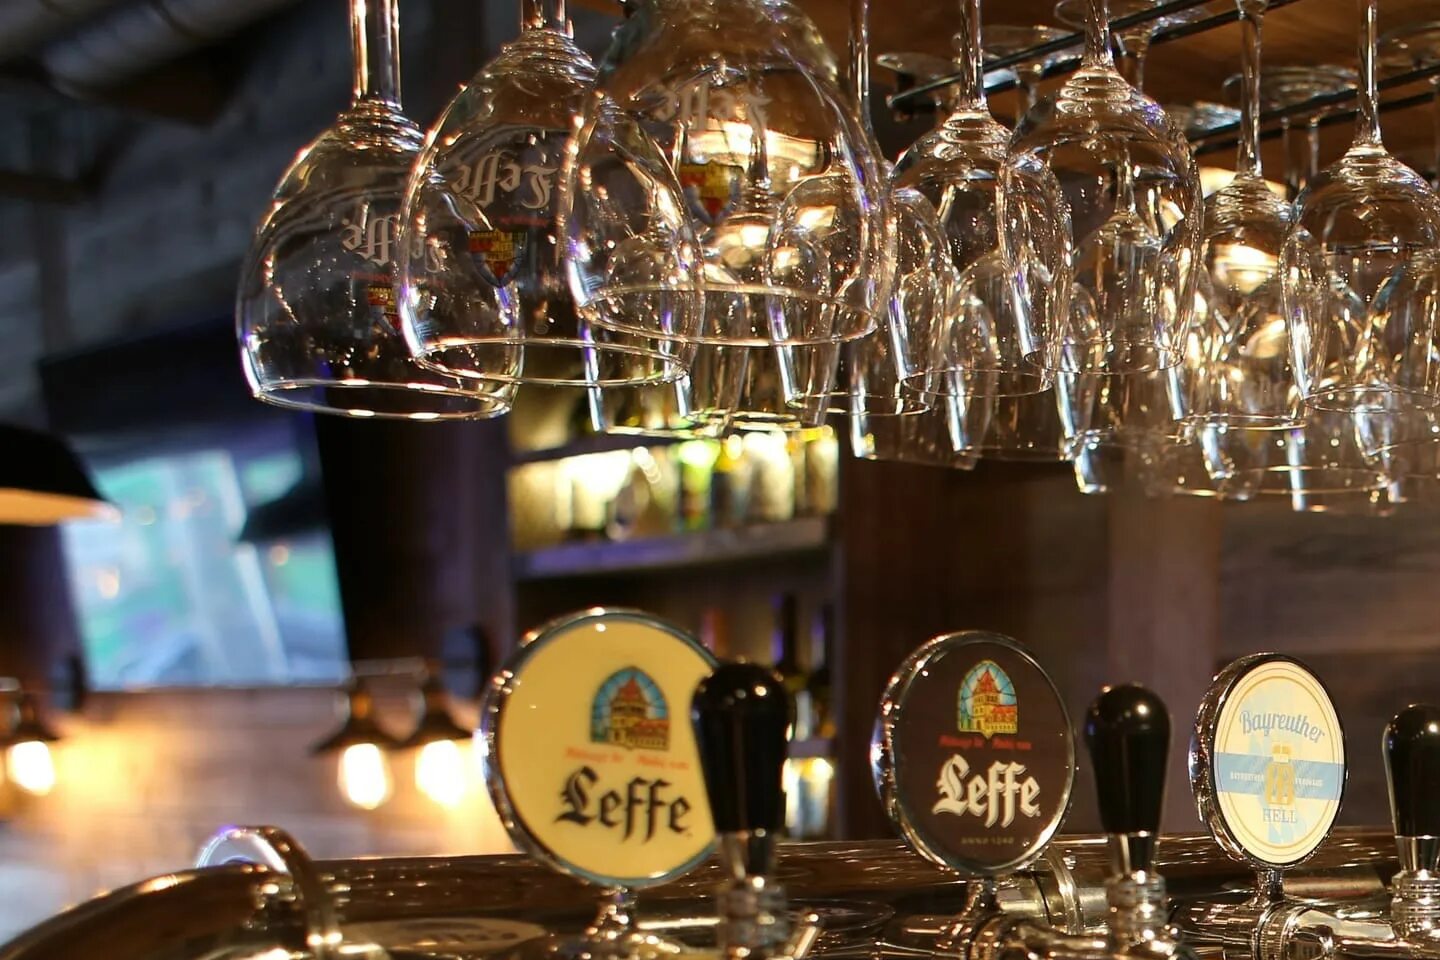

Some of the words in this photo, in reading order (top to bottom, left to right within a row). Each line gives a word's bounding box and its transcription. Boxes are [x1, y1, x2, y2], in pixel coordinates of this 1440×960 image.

[450, 153, 559, 208] Leffe
[1239, 711, 1325, 743] Bayreuther
[554, 766, 692, 844] Leffe
[931, 753, 1041, 829] Leffe
[1263, 808, 1298, 823] HELL
